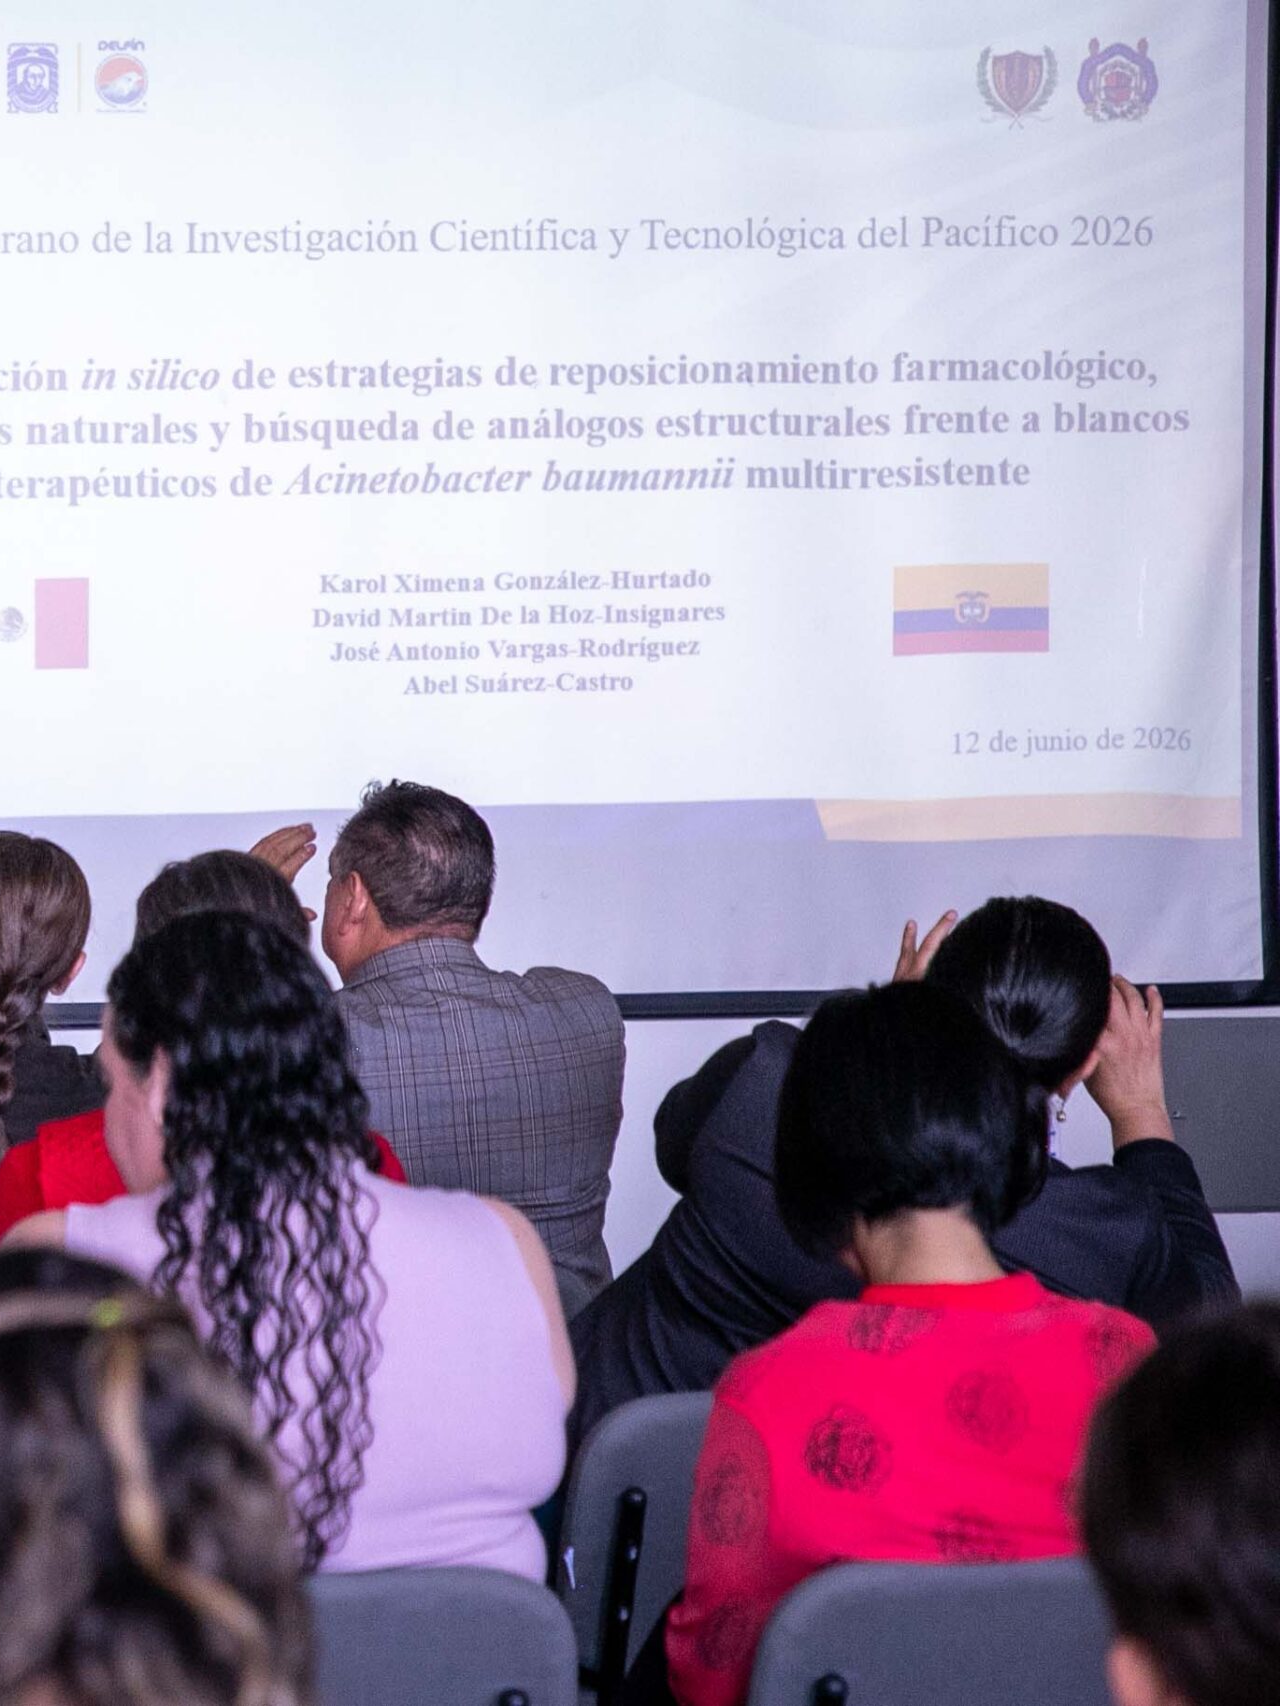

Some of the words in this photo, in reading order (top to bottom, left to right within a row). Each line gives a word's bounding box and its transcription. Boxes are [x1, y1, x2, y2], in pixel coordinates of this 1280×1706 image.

[91, 220, 132, 254] de
[144, 220, 174, 254] la
[186, 219, 419, 261] Investigación
[429, 217, 598, 253] Científica
[608, 228, 630, 260] y
[639, 216, 846, 259] Tecnológica
[856, 215, 909, 250] del
[921, 214, 1059, 248] Pacífico
[1070, 214, 1154, 247] 2026
[81, 358, 116, 391] in
[126, 358, 221, 391] silico
[231, 358, 276, 391] de
[288, 356, 483, 397] estrategias
[494, 355, 538, 387] de
[549, 353, 879, 395] reposicionamiento
[892, 349, 1158, 389] farmacológico,
[26, 412, 198, 445] naturales
[209, 421, 231, 453] y
[243, 410, 419, 451] búsqueda
[432, 409, 475, 441] de
[487, 407, 645, 448] análogos
[655, 406, 891, 438] estructurales
[904, 403, 1010, 435] frente
[1021, 411, 1041, 434] a
[1053, 401, 1190, 433] blancos
[229, 466, 273, 497] de
[282, 461, 533, 496] Acinetobacter
[541, 456, 736, 492] baumannii
[746, 456, 1030, 490] multirresistente
[320, 573, 387, 594] Karol
[394, 573, 485, 594] Ximena
[493, 568, 712, 591] González-Hurtado
[312, 607, 381, 628] David
[480, 606, 513, 626] De
[520, 604, 541, 625] la
[548, 604, 726, 629] Hoz-Insignares
[329, 640, 381, 662] José
[386, 641, 481, 662] Antonio
[487, 636, 700, 664] Vargas-Rodríguez
[403, 674, 458, 696] Abel
[465, 671, 634, 694] Suárez-Castro
[953, 730, 980, 755] 12
[988, 729, 1018, 754] de
[1022, 728, 1088, 759] junio
[1095, 726, 1125, 751] de
[1133, 726, 1192, 752] 2026
